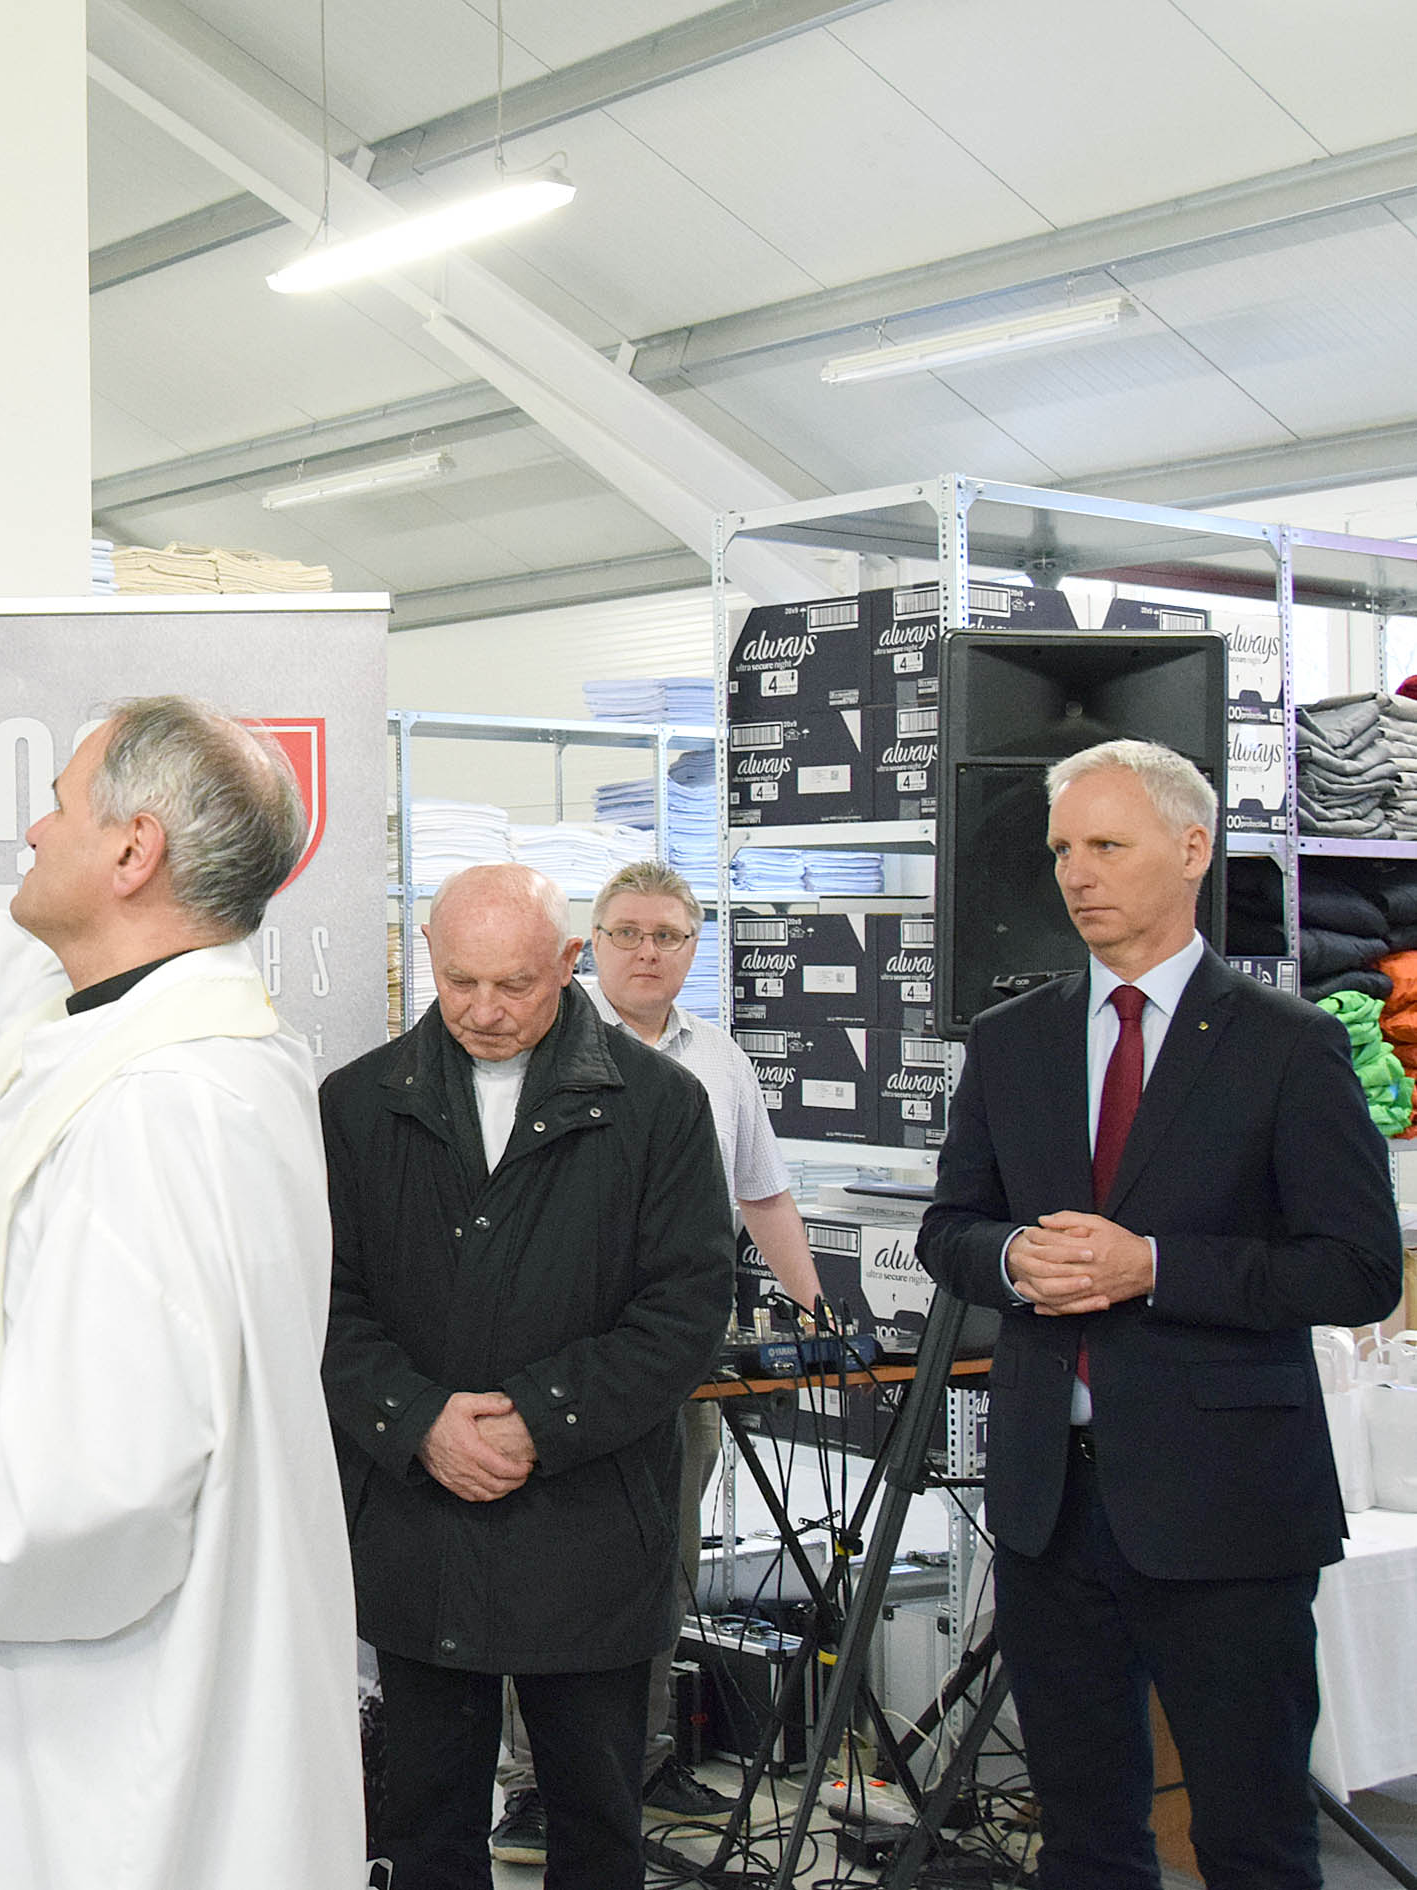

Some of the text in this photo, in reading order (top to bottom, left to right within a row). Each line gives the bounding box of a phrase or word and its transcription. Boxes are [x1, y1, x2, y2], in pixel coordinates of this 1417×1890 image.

[879, 622, 938, 650] always
[1226, 624, 1280, 664] always
[743, 630, 818, 666] always
[736, 660, 792, 672] ultra secure night
[900, 657, 908, 671] 4
[768, 676, 778, 694] 4
[1228, 706, 1241, 720] 00
[882, 740, 938, 768] always
[737, 752, 792, 780] always
[903, 776, 910, 789] 4
[756, 786, 763, 798] 4
[1226, 815, 1241, 828] 00
[742, 948, 797, 976] always
[761, 982, 768, 994] 4
[907, 986, 915, 999] 4
[754, 1059, 796, 1089] lways
[887, 1067, 945, 1099] always
[908, 1104, 915, 1118] 4
[866, 1269, 928, 1286] ultra secure night
